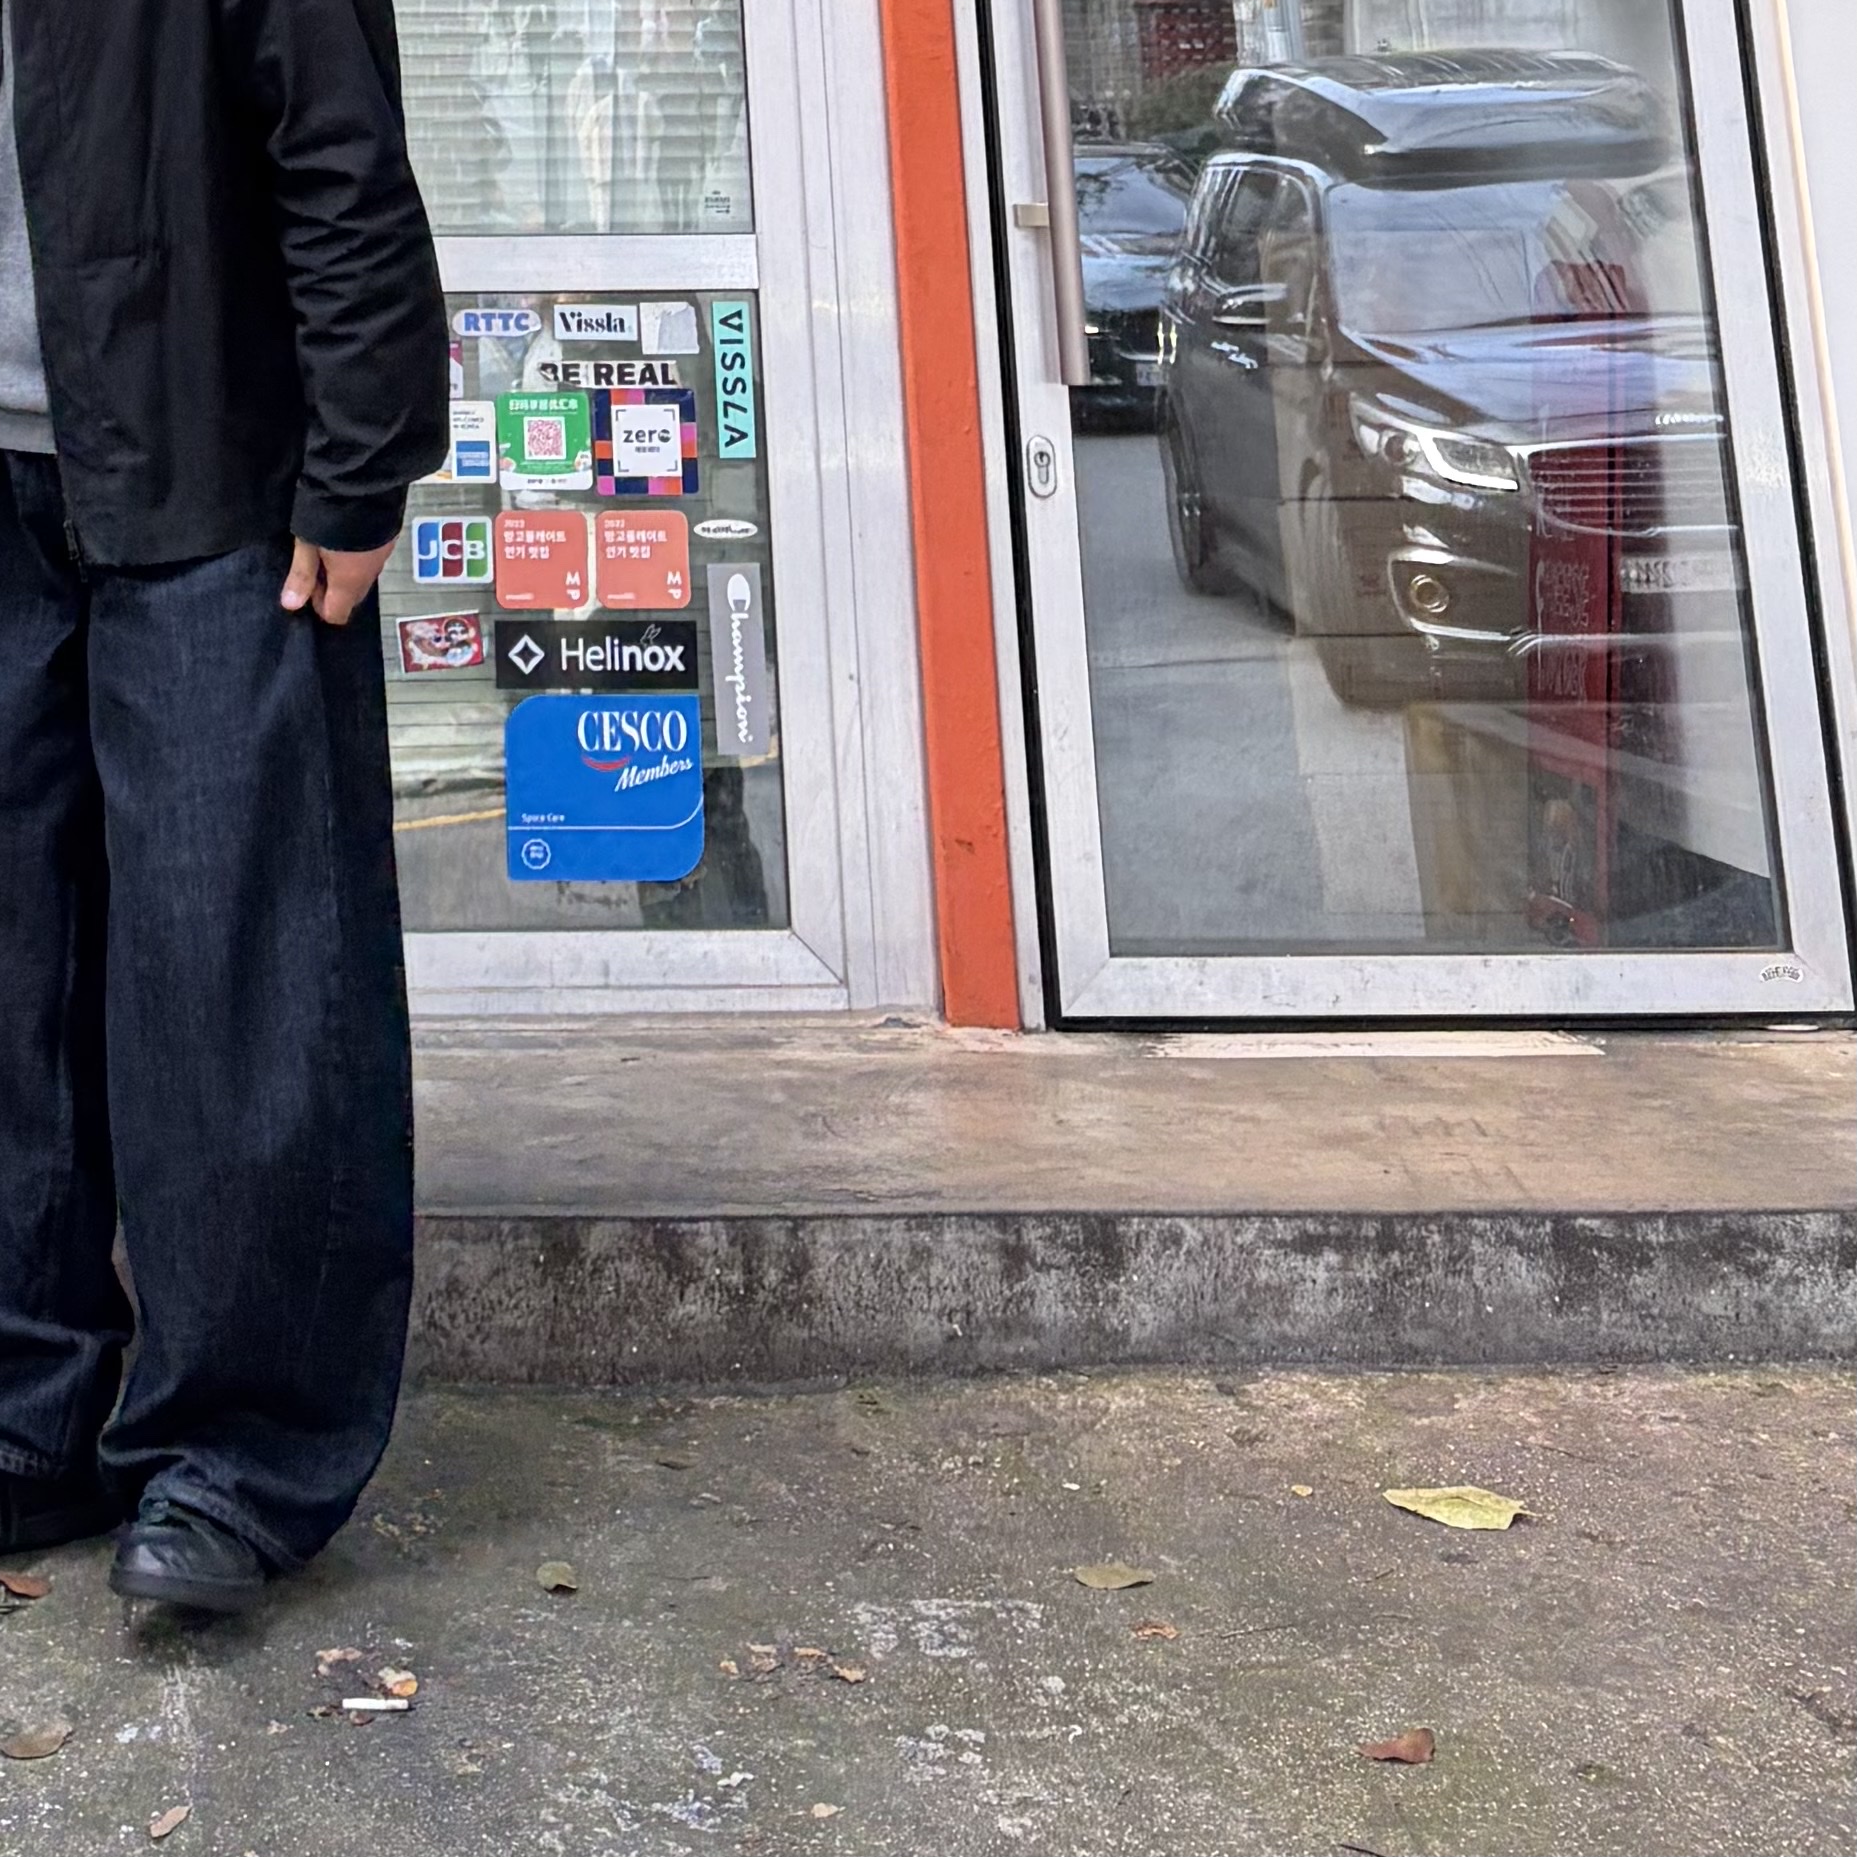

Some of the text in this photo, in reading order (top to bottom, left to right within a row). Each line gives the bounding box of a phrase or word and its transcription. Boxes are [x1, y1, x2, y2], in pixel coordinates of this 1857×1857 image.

[463, 312, 530, 332] RTTC
[718, 308, 749, 448] VISSLA
[418, 538, 485, 560] JCB
[560, 635, 686, 672] Helinox
[724, 572, 754, 744] Champion
[577, 710, 688, 752] CESCO
[613, 754, 694, 792] Members
